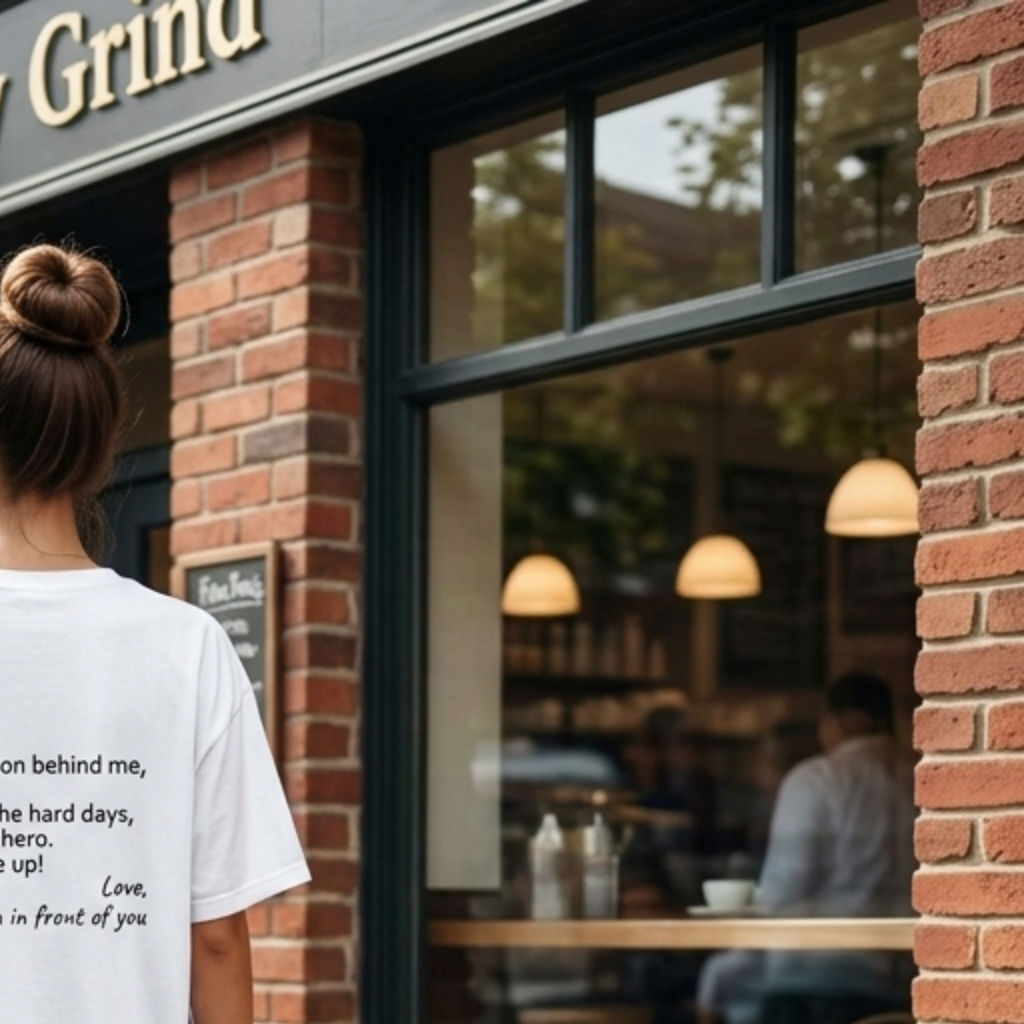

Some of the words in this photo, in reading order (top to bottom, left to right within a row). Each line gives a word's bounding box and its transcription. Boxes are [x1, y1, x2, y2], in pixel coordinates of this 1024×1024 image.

[32, 754, 102, 775] behind
[108, 759, 147, 779] me,
[29, 803, 75, 823] hard
[81, 803, 134, 829] days,
[1, 828, 53, 848] hero.
[12, 854, 43, 879] up!
[101, 874, 147, 898] Love,
[10, 908, 27, 926] in
[34, 904, 86, 929] front
[91, 904, 115, 929] of
[114, 911, 147, 932] you
